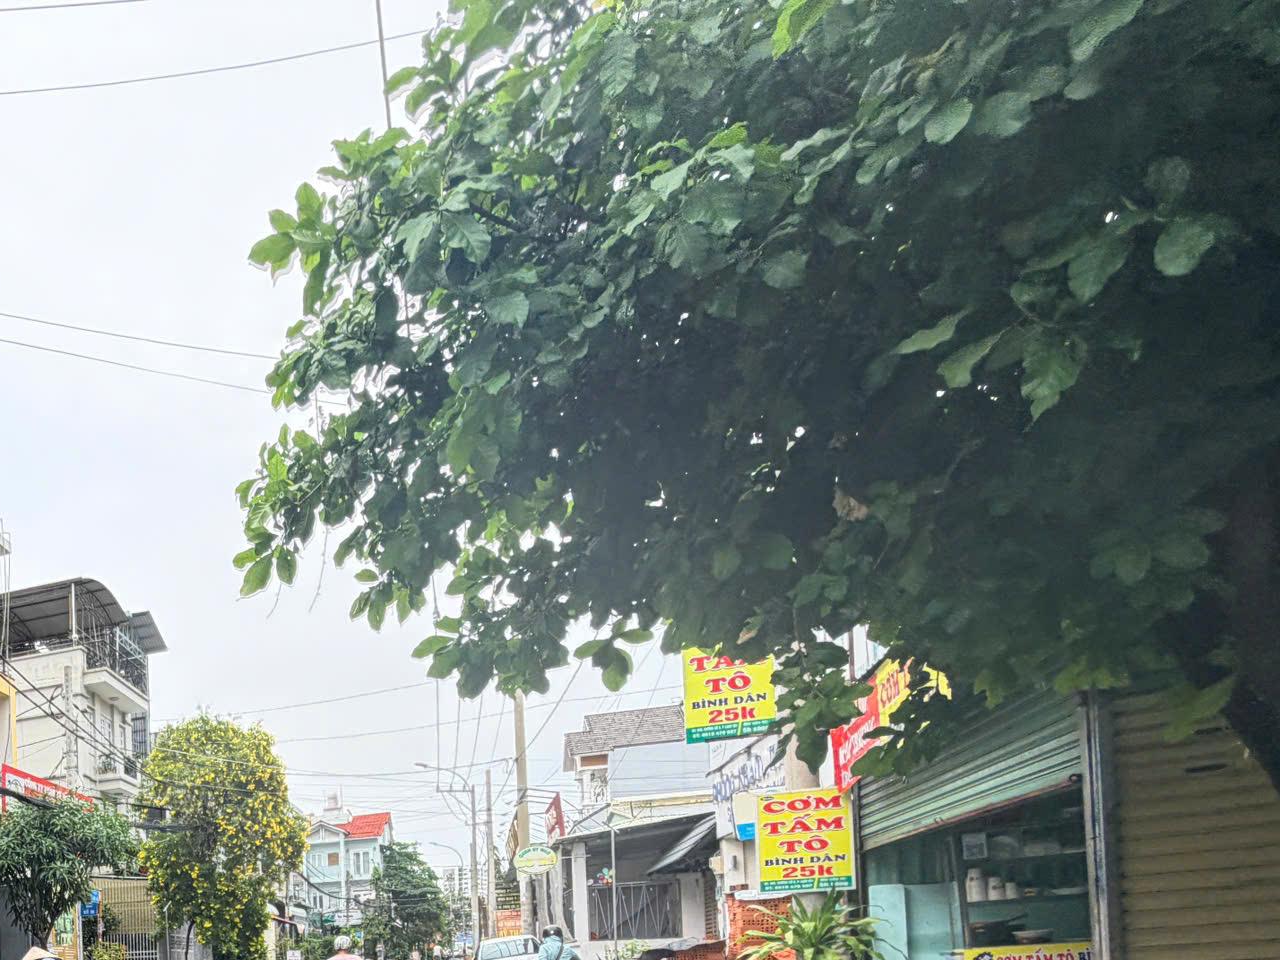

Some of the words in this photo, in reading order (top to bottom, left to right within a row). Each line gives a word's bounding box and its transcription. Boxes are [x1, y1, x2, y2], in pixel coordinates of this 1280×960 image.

[705, 671, 751, 693] TÔ
[692, 697, 728, 709] BÌNH
[734, 693, 767, 705] DÂN
[763, 795, 842, 814] CƠM
[763, 814, 844, 835] TẤM
[779, 835, 829, 853] TÔ
[764, 856, 804, 867] BÌNH
[810, 853, 846, 863] DÂN
